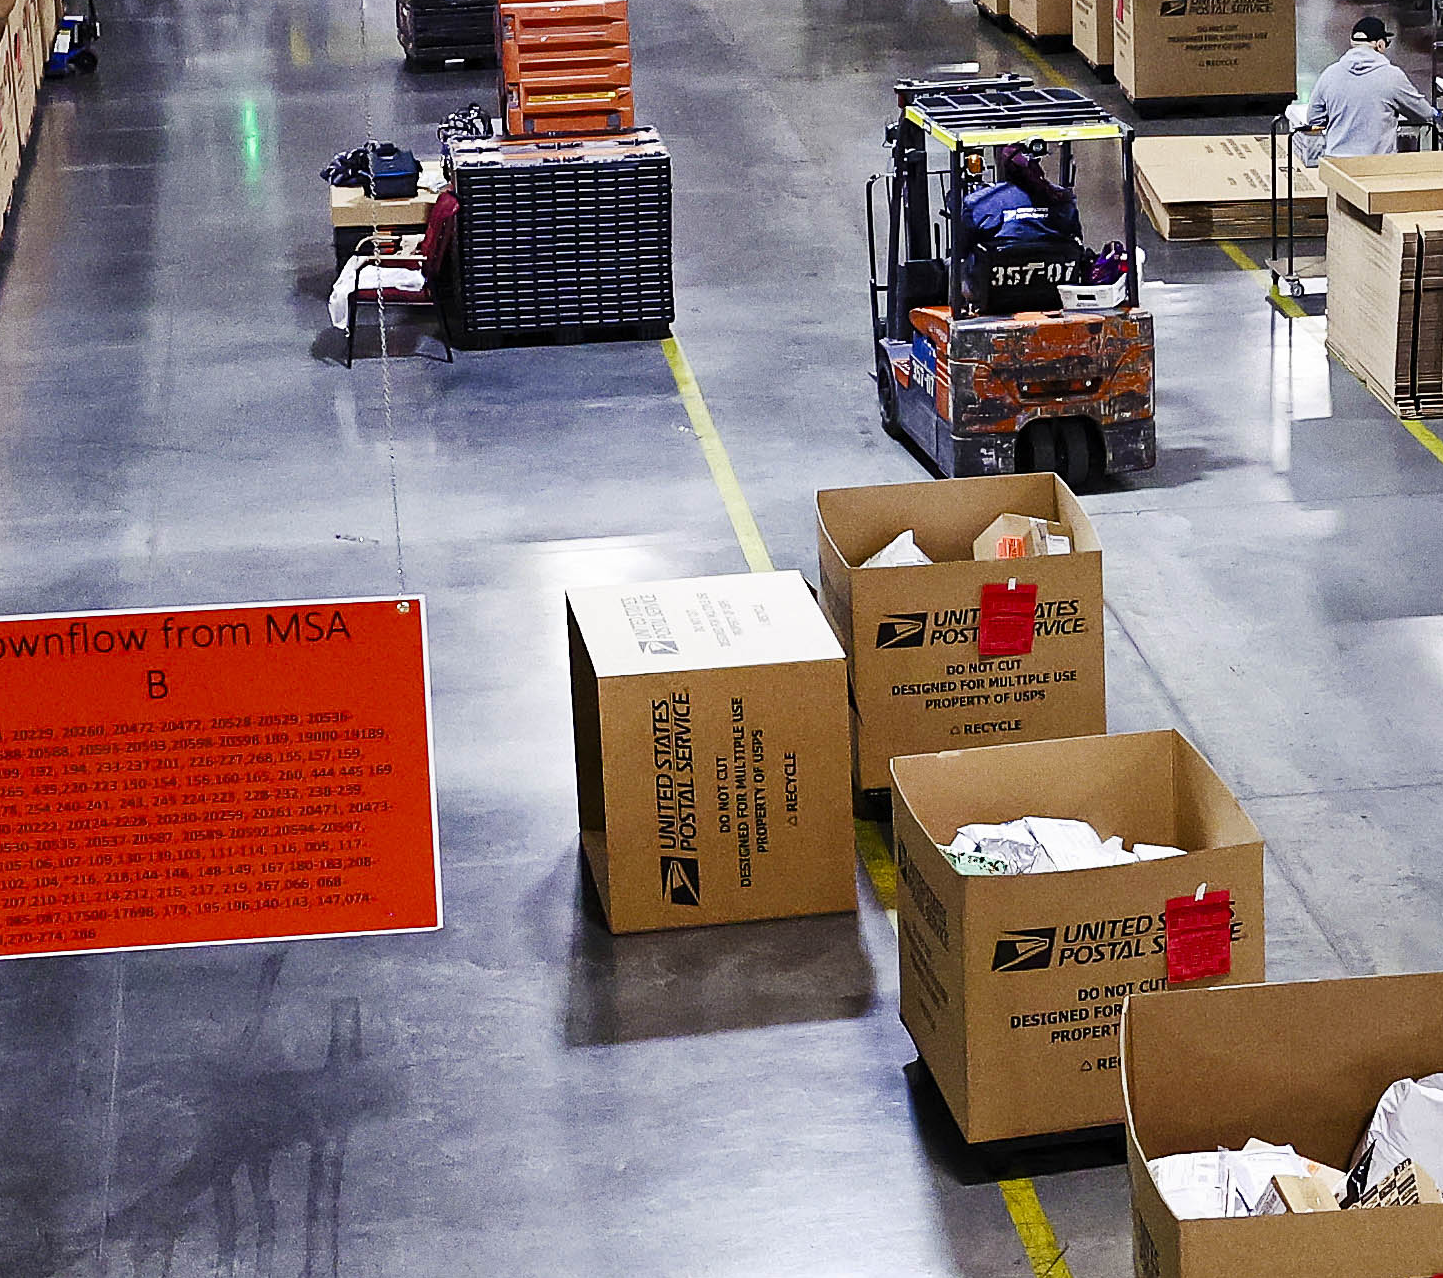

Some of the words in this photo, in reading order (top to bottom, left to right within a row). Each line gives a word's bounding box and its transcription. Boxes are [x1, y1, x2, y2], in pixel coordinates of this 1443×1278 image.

[1188, 7, 1229, 17] POSTAL
[991, 261, 1076, 287] 357-07
[162, 619, 252, 652] from
[265, 611, 351, 643] MSA
[147, 670, 169, 700] B
[731, 696, 745, 723] USE
[651, 700, 674, 772] STATES
[671, 690, 694, 774] SERVICE
[752, 730, 765, 765] USPS
[716, 756, 729, 783] CUT
[733, 726, 748, 792] MULTIPLE
[753, 767, 766, 786] OF
[717, 787, 731, 814] NOT
[784, 753, 798, 814] RECYCLE
[656, 775, 678, 851] UNITED
[677, 780, 699, 854] POSTAL
[735, 794, 748, 821] FOR
[754, 789, 768, 855] PROPERTY
[719, 817, 731, 836] DO
[736, 824, 751, 889] DESIGNED
